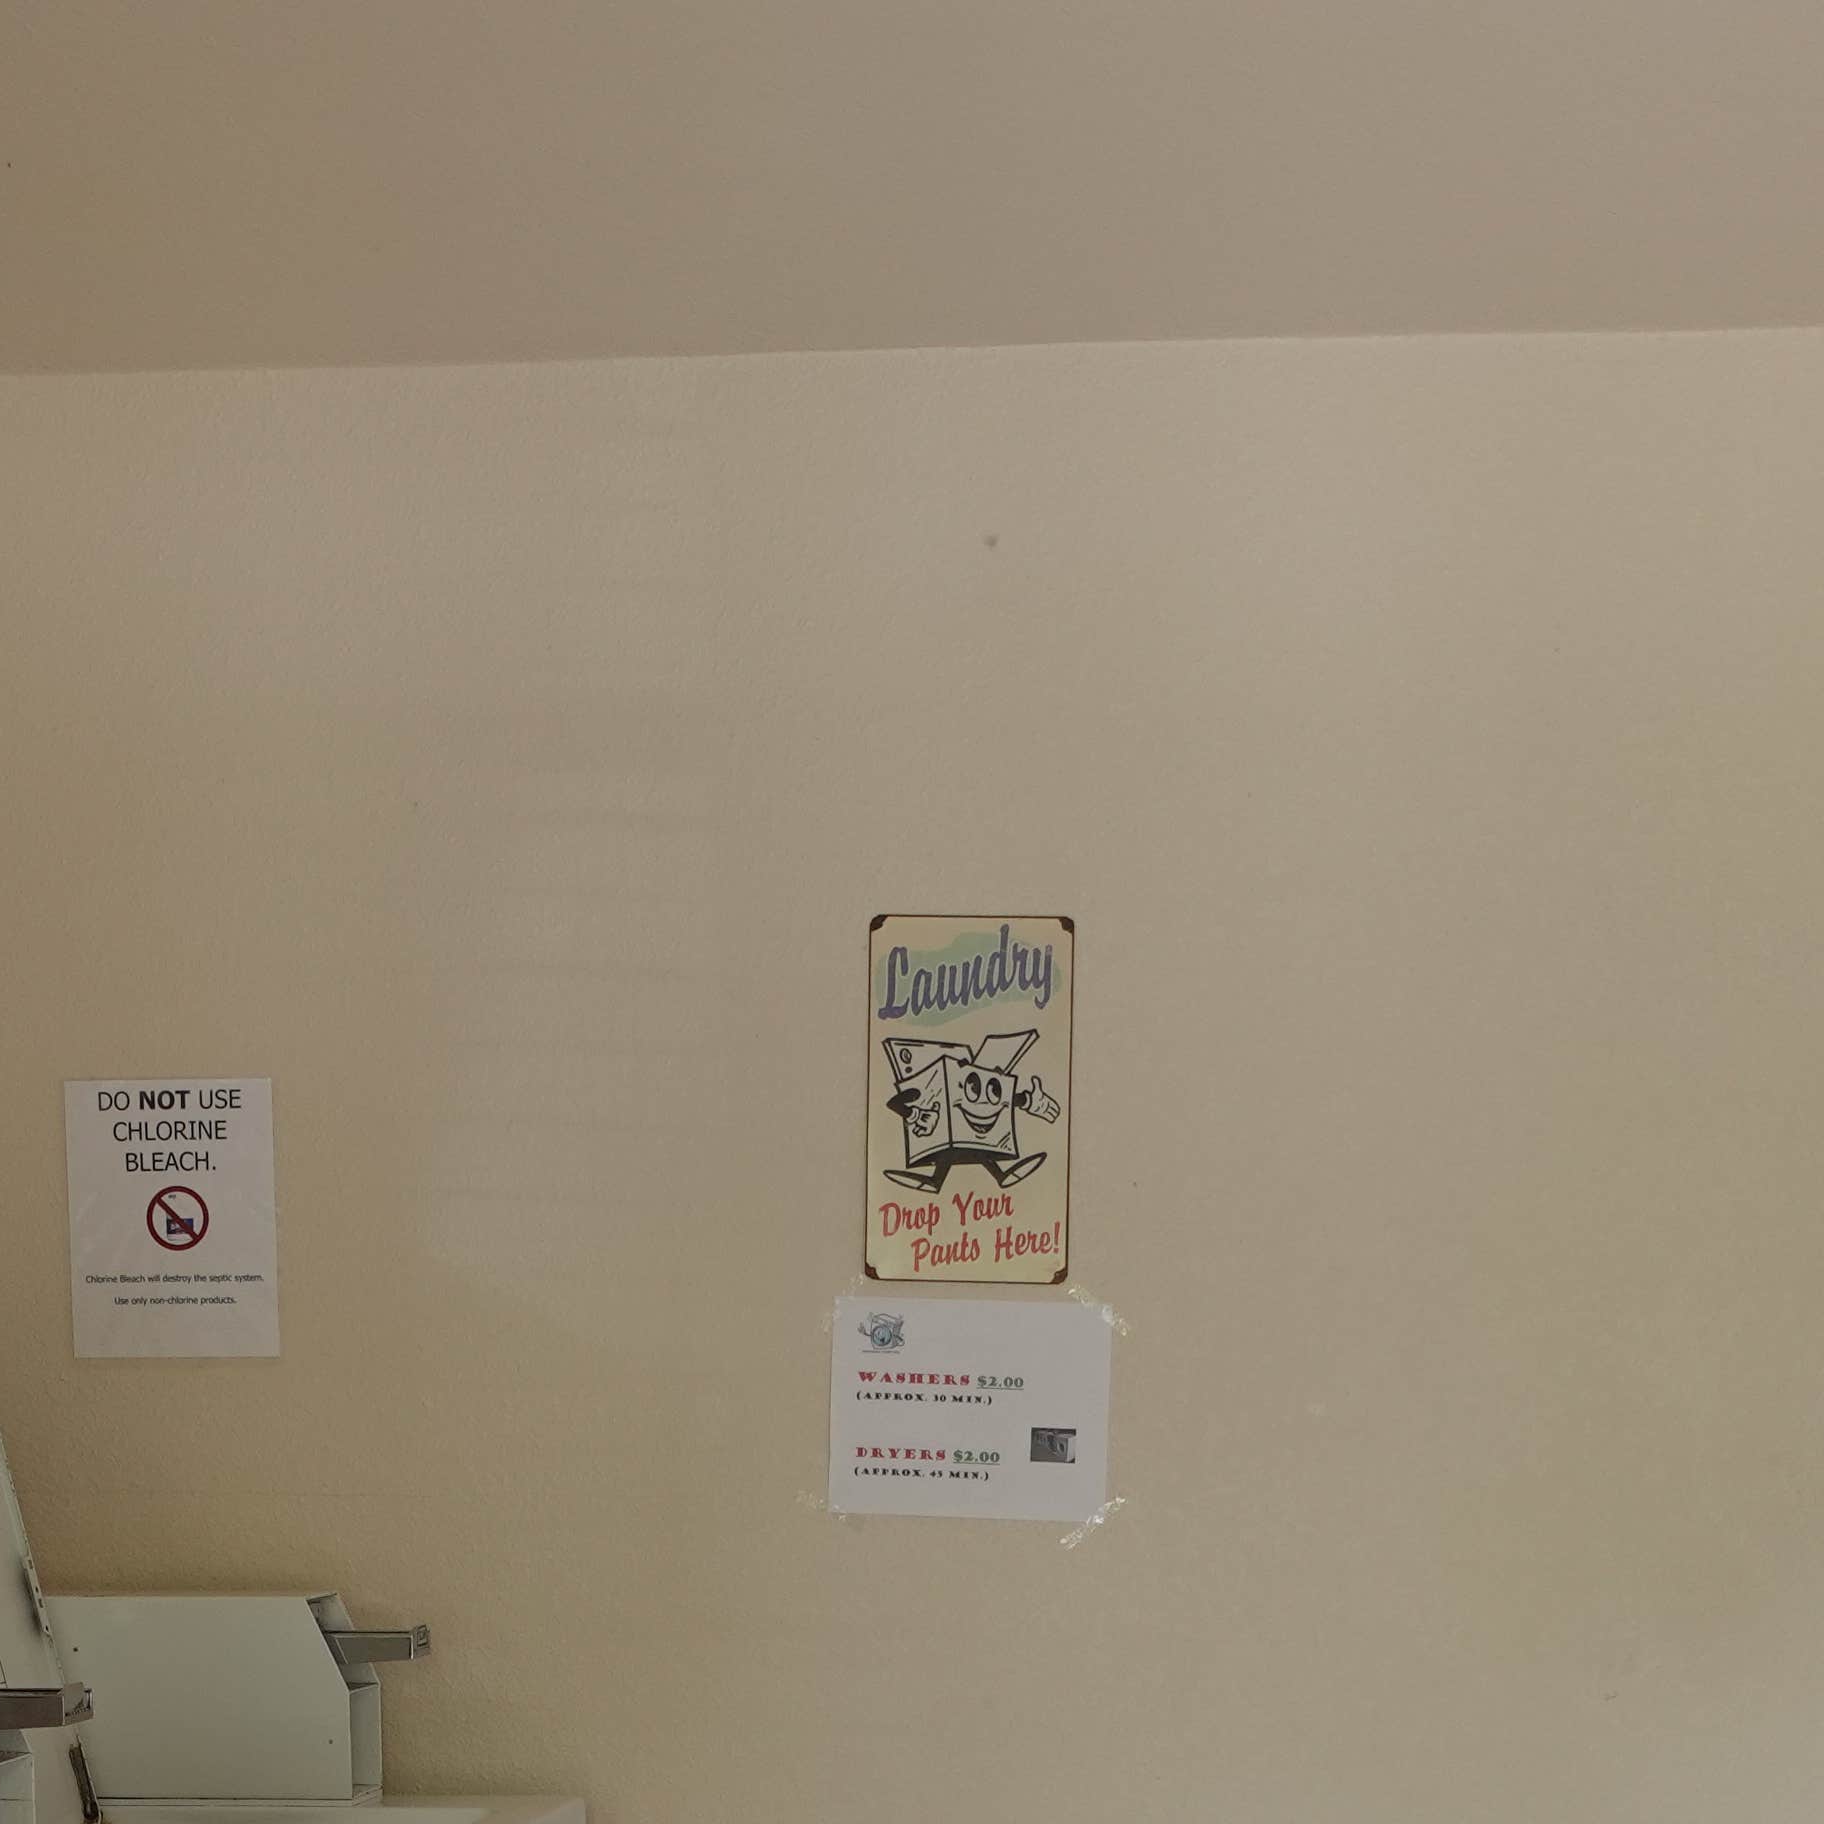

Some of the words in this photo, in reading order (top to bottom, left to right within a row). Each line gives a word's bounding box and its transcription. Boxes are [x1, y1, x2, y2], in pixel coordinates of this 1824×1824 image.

[878, 924, 1053, 1019] Laundry
[98, 1092, 129, 1111] DO
[139, 1090, 190, 1110] NOT
[199, 1089, 241, 1109] USE
[113, 1120, 227, 1142] CHLORINE
[126, 1151, 215, 1172] BLEACH.
[879, 1202, 940, 1237] Drop
[952, 1191, 1013, 1222] Your
[911, 1231, 979, 1272] Pants
[995, 1222, 1060, 1263] Here!
[86, 1275, 117, 1284] Chlorine
[120, 1275, 145, 1283] Bleach
[147, 1274, 160, 1283] will
[163, 1274, 191, 1285] destroy
[194, 1274, 207, 1282] the
[209, 1273, 232, 1284] septic
[234, 1274, 263, 1284] system.
[115, 1297, 128, 1305] Use
[132, 1296, 147, 1306] only
[150, 1296, 198, 1305] non-chlorine
[200, 1296, 236, 1305] products.
[858, 1371, 970, 1385] WASHERS
[977, 1376, 1024, 1388] $2.00
[856, 1391, 927, 1402] (APPROX.
[952, 1395, 992, 1405] MIN.)
[856, 1447, 946, 1460] DRYERS
[953, 1450, 1000, 1463] $2.00
[854, 1467, 925, 1478] (APPROX.
[929, 1470, 943, 1478] 45
[949, 1470, 989, 1481] MIN.)
